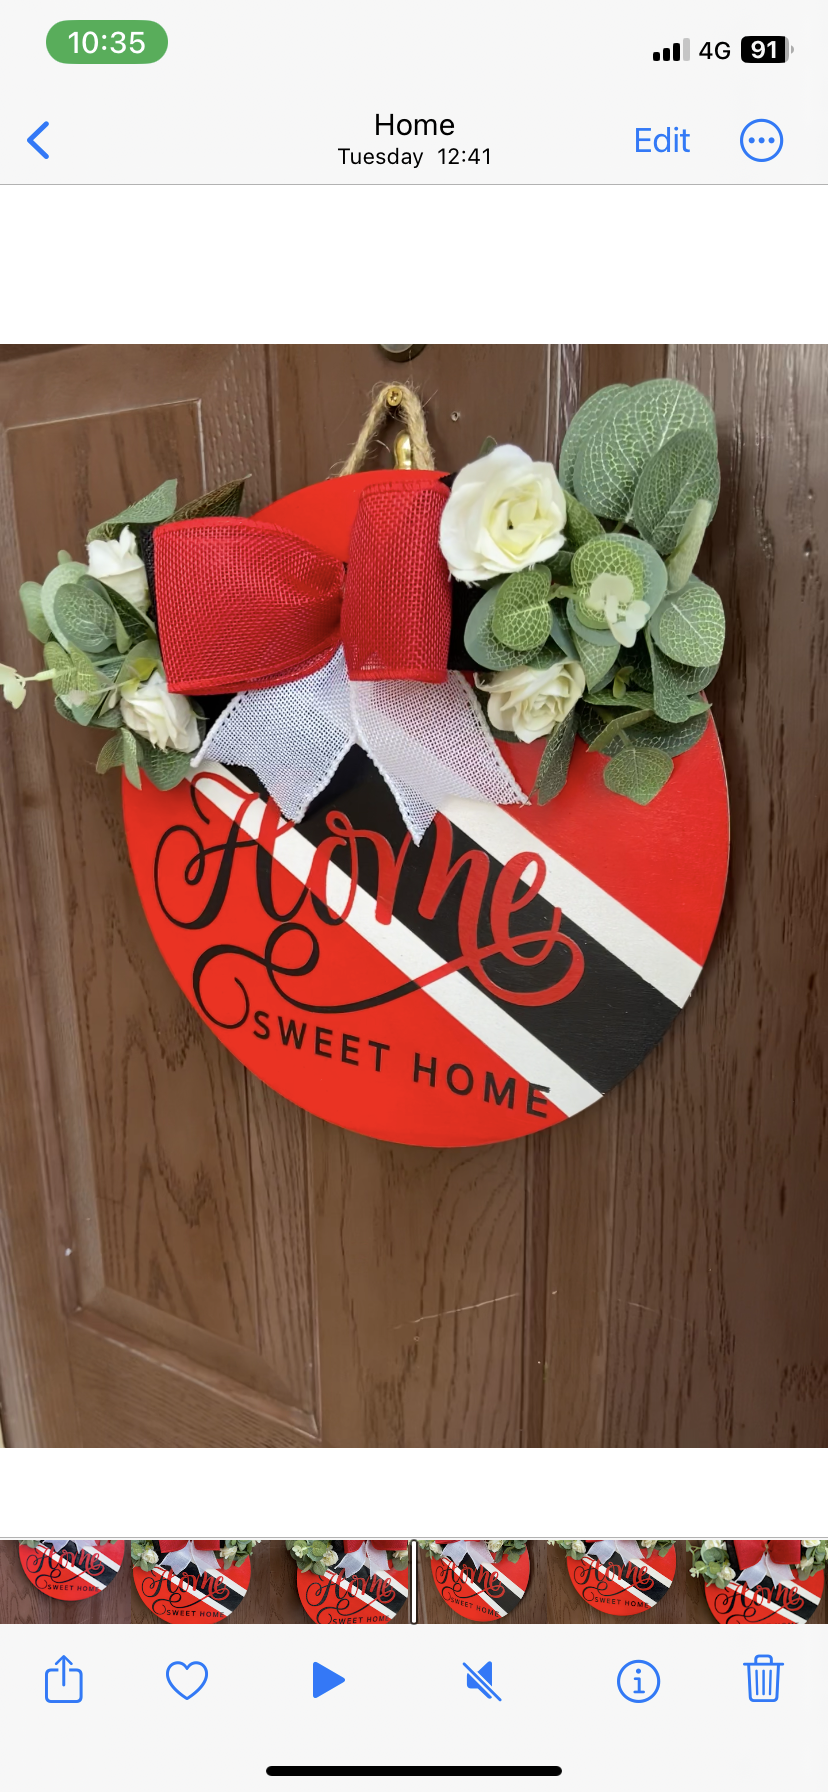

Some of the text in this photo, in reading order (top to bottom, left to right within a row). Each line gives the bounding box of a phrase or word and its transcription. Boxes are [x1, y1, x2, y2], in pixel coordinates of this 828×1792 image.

[68, 30, 146, 55] 10:35
[698, 40, 731, 61] 4G
[750, 40, 777, 60] 91
[375, 113, 455, 137] Home
[635, 126, 691, 153] Edit
[337, 147, 490, 169] Tuesday 12:41
[154, 771, 585, 1030] Home
[253, 1009, 551, 1119] SWEET HOME
